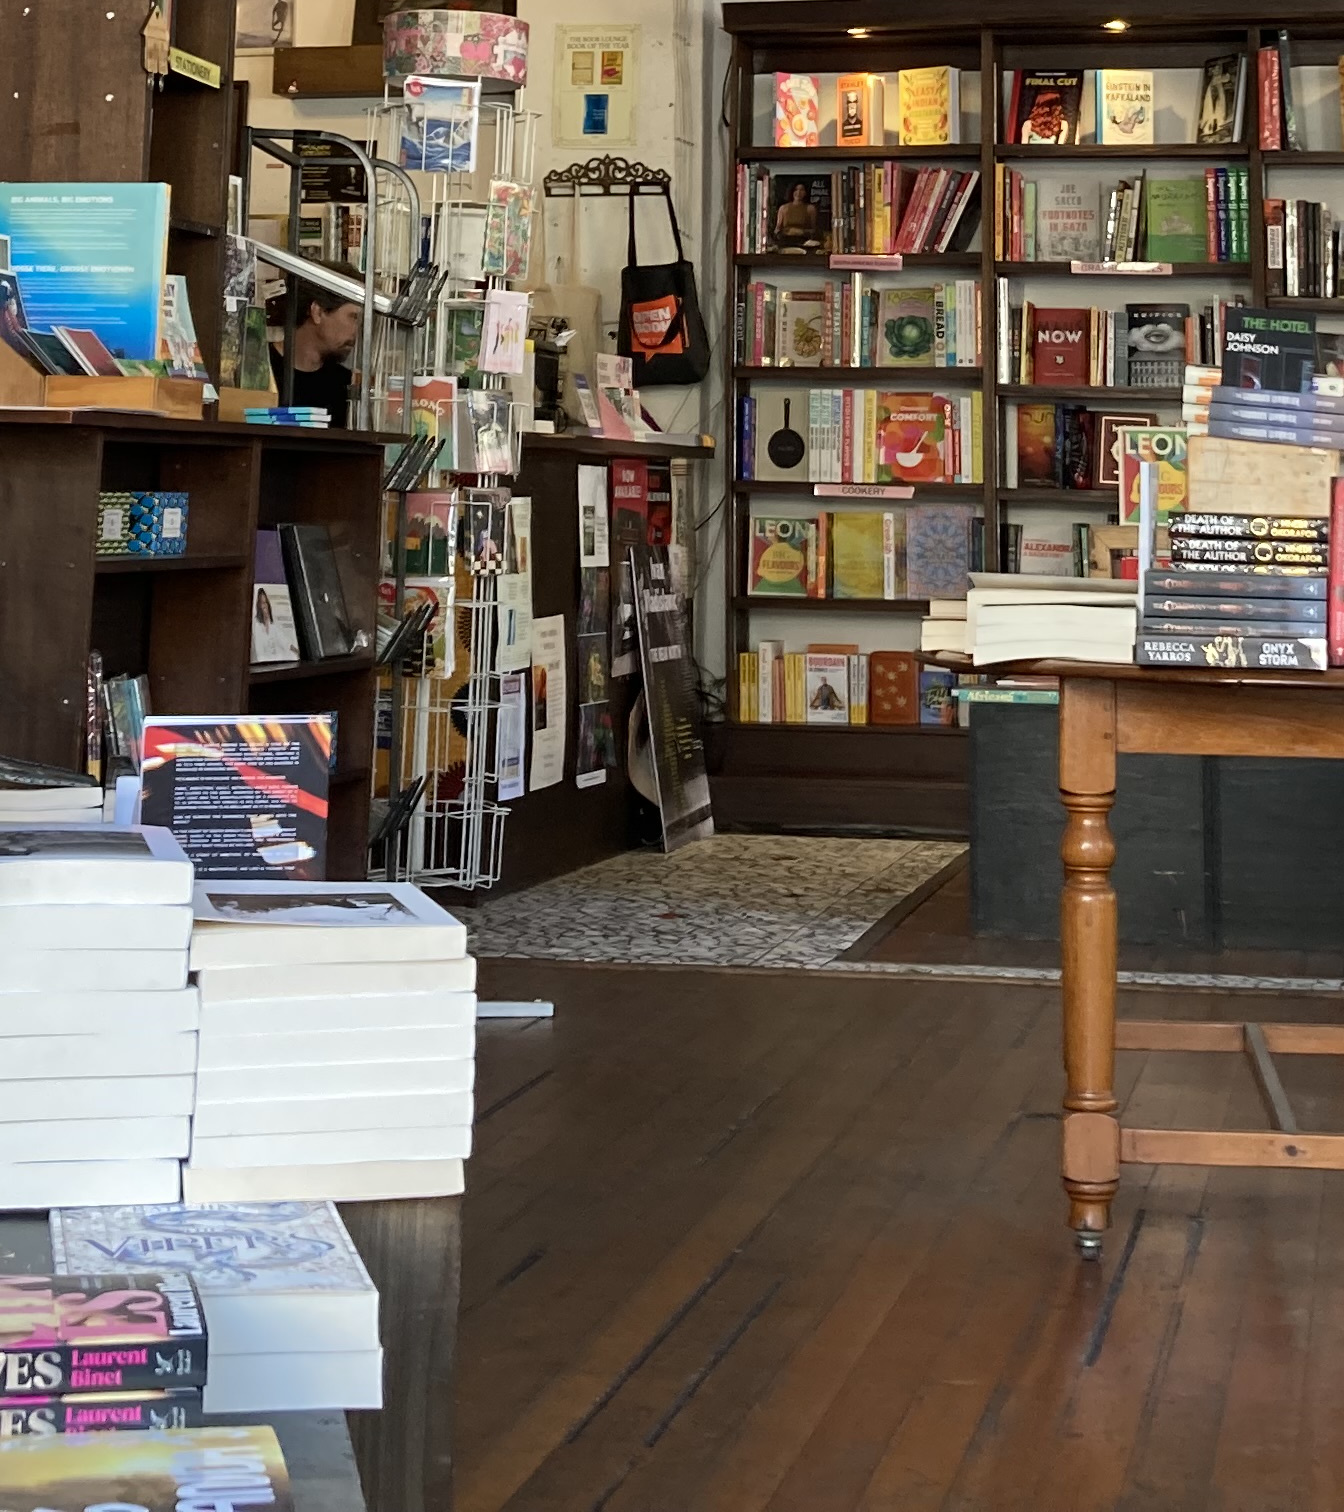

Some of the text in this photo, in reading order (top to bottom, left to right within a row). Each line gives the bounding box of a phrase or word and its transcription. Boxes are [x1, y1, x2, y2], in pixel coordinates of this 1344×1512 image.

[1025, 76, 1079, 87] FINAL CUT
[1059, 184, 1076, 194] JOE
[1054, 195, 1082, 206] SACCO
[1042, 210, 1095, 221] FOOTNOTES
[1049, 222, 1089, 233] IN GAZA
[736, 302, 746, 342] ferment
[935, 300, 945, 339] BREAD
[1242, 317, 1313, 334] THE HOTEL
[1037, 330, 1083, 344] NOW
[1226, 332, 1256, 344] DAISY
[1226, 342, 1280, 356] JOHNSON
[890, 412, 938, 422] COMFORT
[842, 486, 887, 496] COOKERY
[1184, 514, 1235, 525] DEATH OF
[1177, 524, 1243, 535] THE AUTHOR
[1188, 541, 1239, 553] DEATH OF
[1182, 549, 1247, 561] THE AUTHOR
[1144, 641, 1295, 655] REBECCA ONYX
[1148, 651, 1299, 666] YARROS STORM
[70, 1345, 149, 1368] Laurent
[70, 1365, 124, 1387] Binet
[65, 1402, 143, 1425] Laurent
